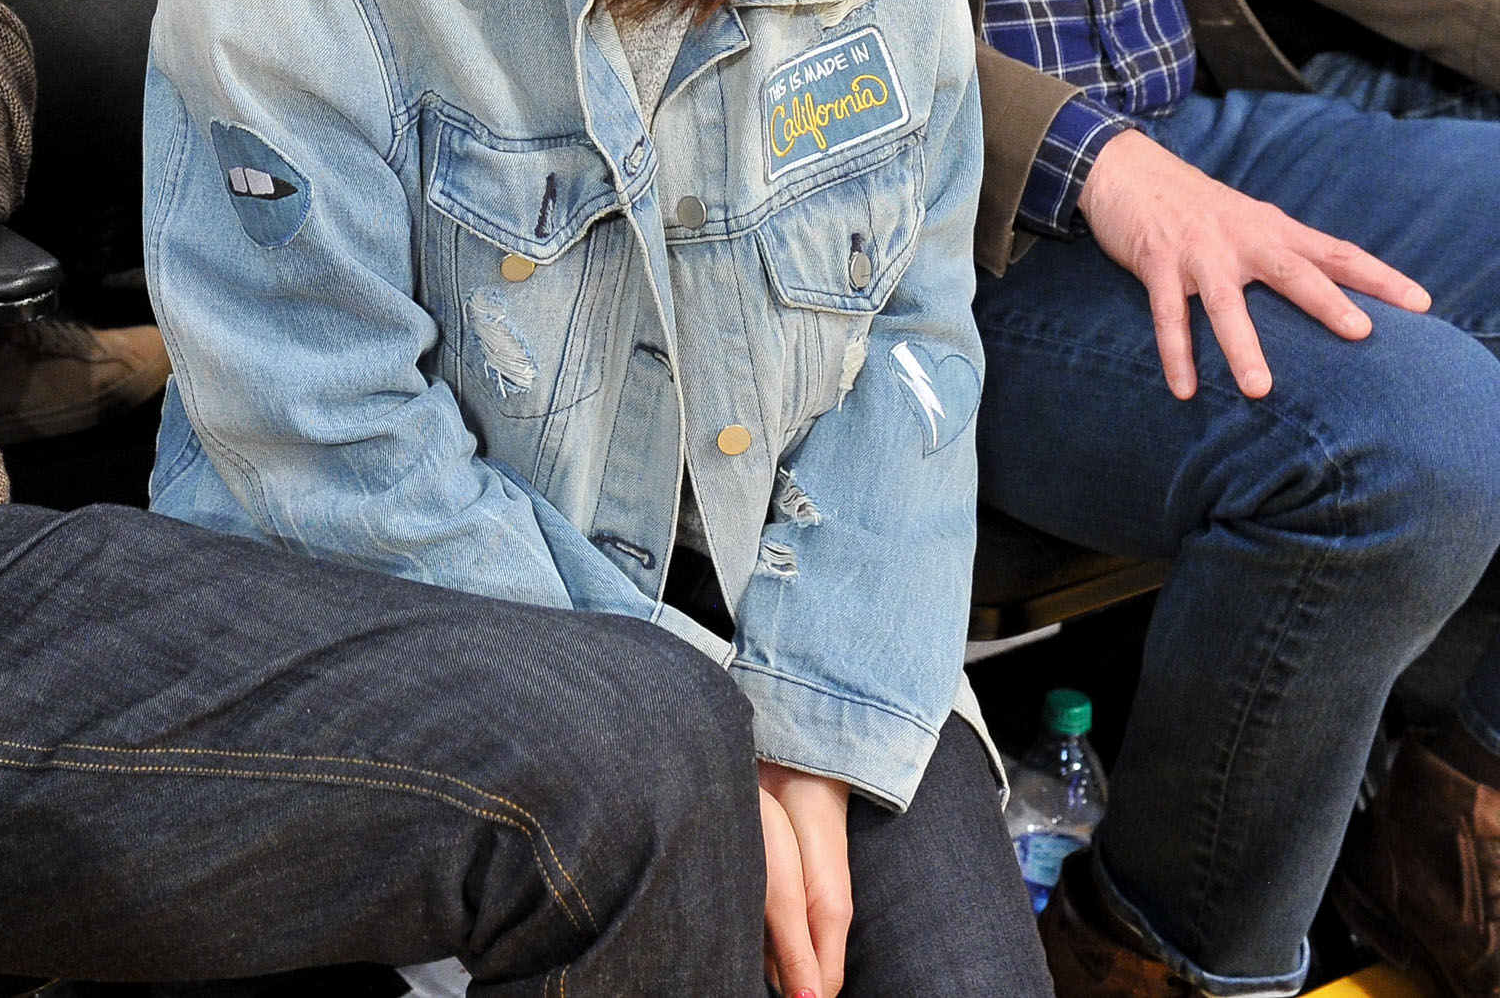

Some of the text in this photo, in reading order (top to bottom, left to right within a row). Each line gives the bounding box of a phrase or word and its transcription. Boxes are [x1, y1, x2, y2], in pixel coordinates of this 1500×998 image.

[768, 78, 787, 105] THIS
[803, 53, 849, 85] MADE
[850, 42, 870, 65] IN
[771, 74, 888, 157] California
